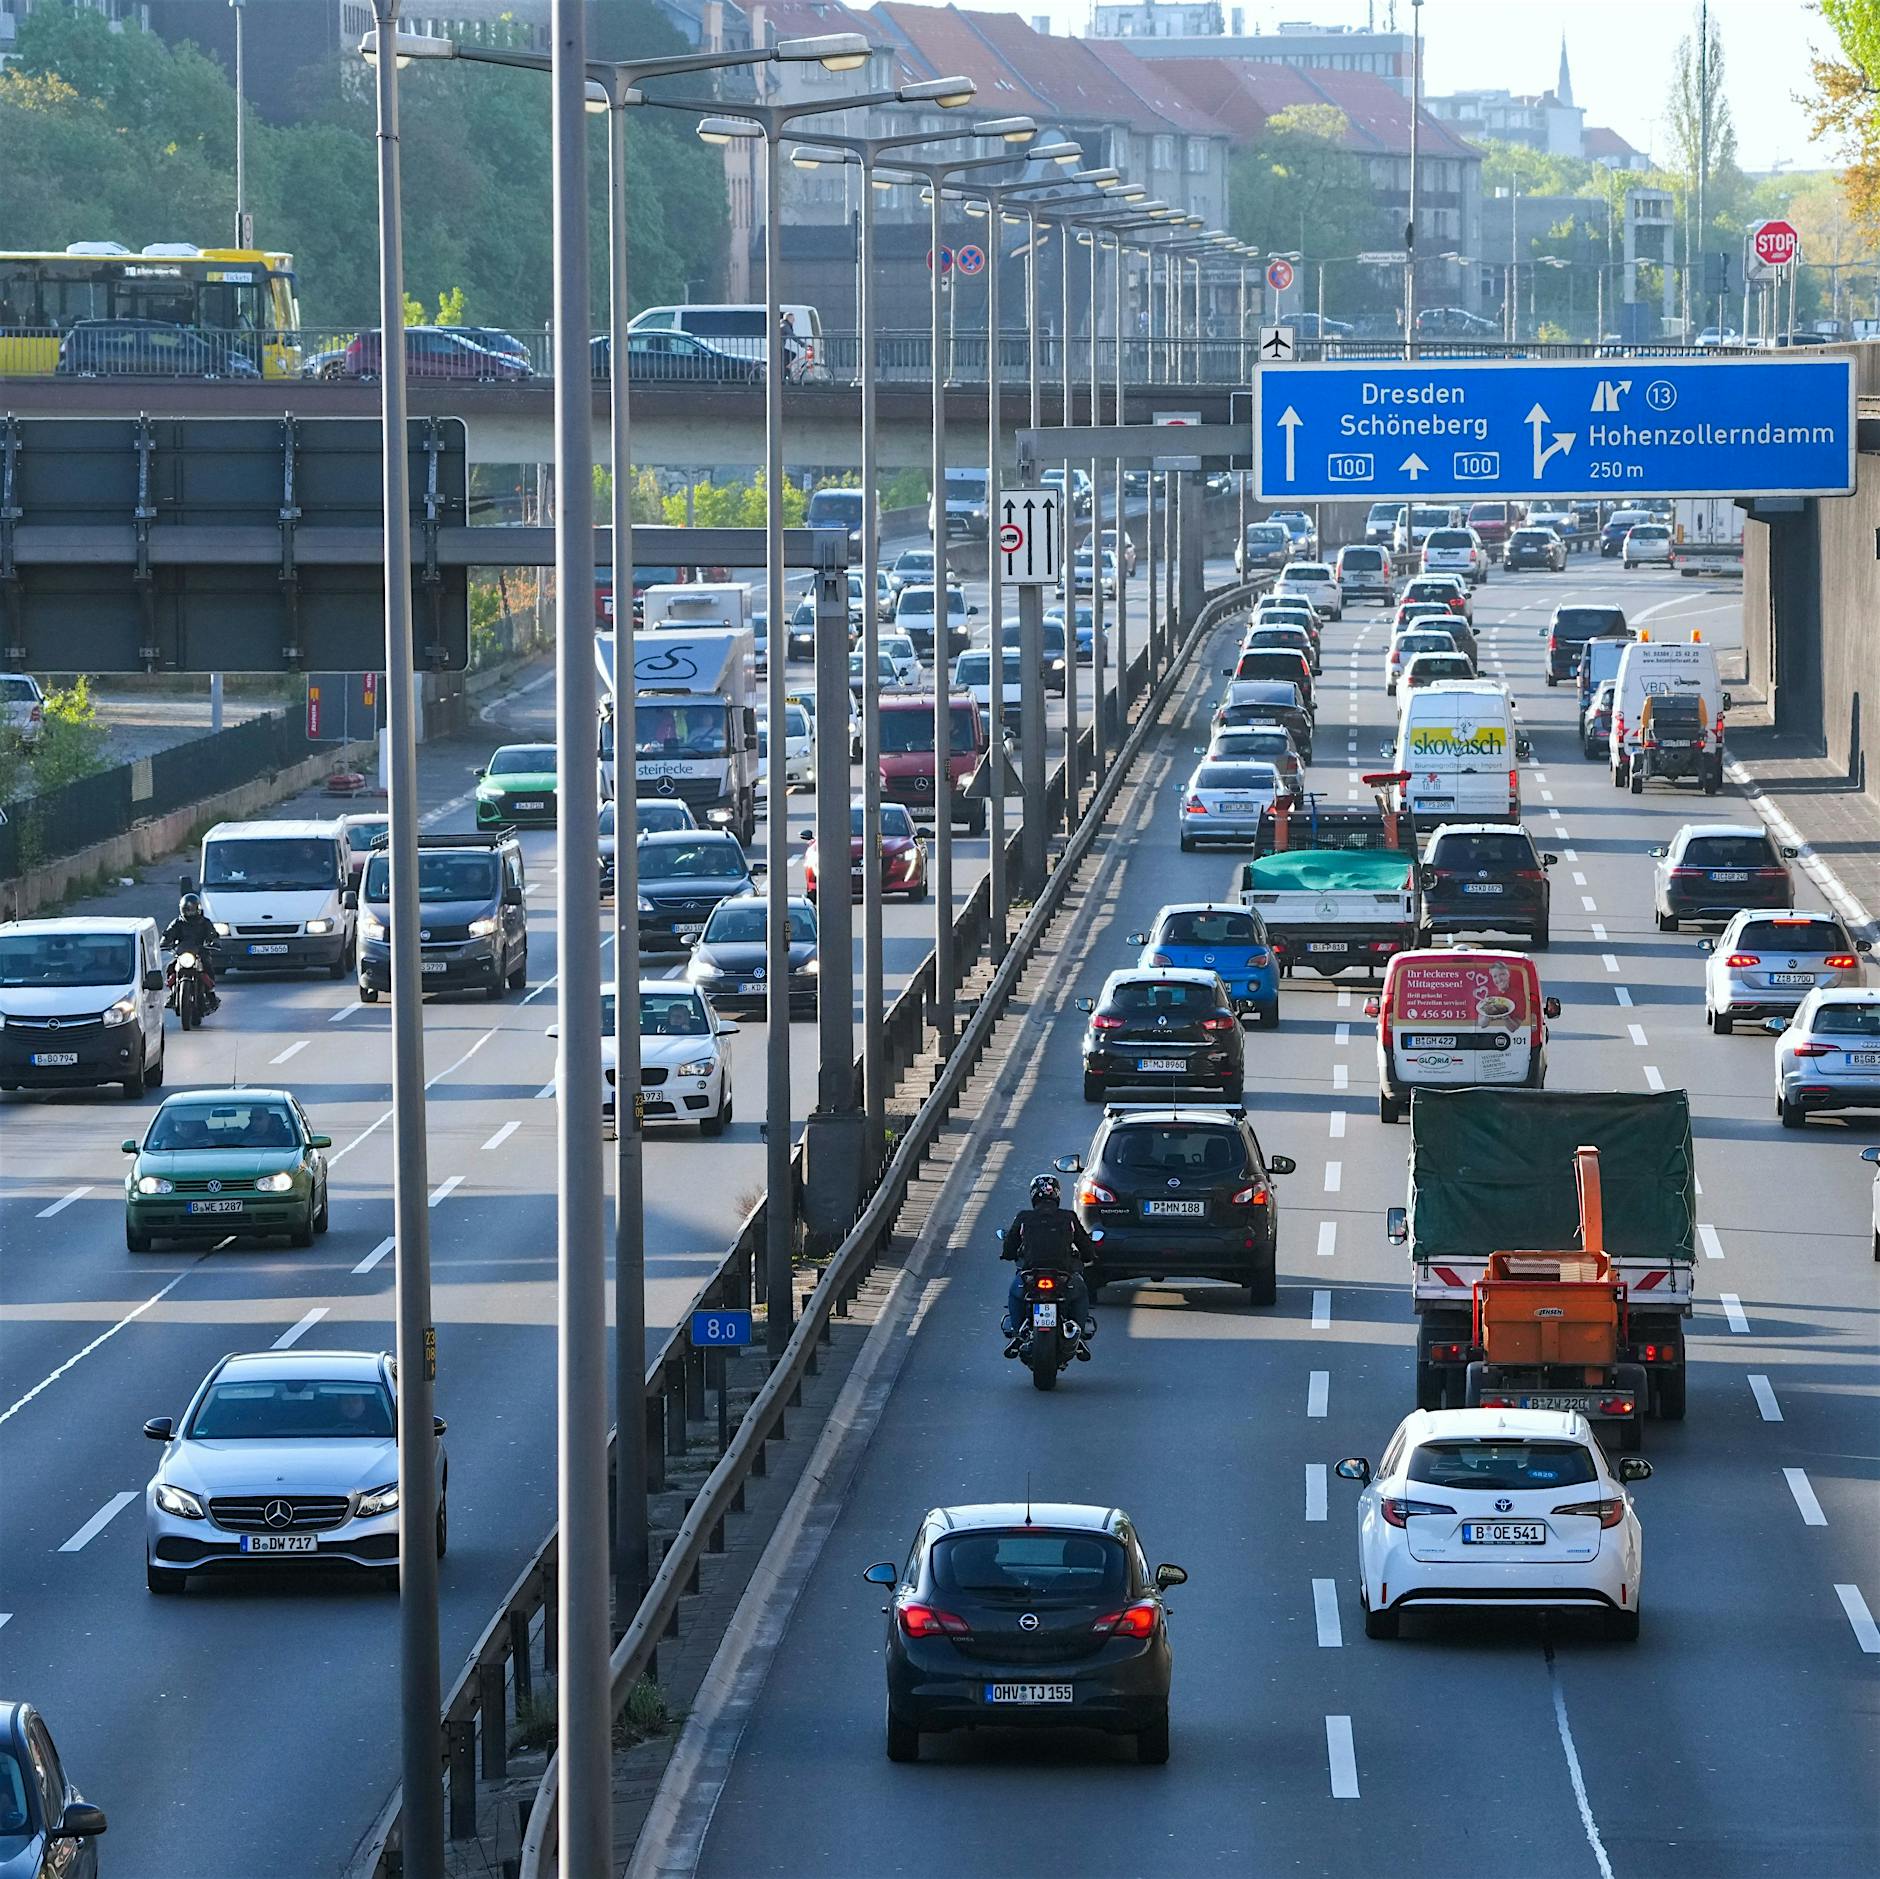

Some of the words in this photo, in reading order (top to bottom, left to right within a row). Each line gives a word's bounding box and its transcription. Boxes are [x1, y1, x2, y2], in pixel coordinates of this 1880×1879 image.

[1758, 233, 1796, 253] STOP
[1362, 383, 1465, 405] Dresden
[1652, 387, 1671, 404] 13
[1340, 414, 1488, 440] Schöneberg
[1588, 423, 1835, 447] Hohenzollerndamm
[1336, 459, 1366, 476] 100
[1461, 457, 1491, 474] 100
[1589, 461, 1622, 479] 250
[1627, 464, 1644, 478] m
[1413, 731, 1503, 757] skowasch
[1407, 969, 1421, 978] Ihr
[1423, 969, 1459, 978] leckeres
[1407, 980, 1463, 989] Mittagessen!
[1421, 1009, 1439, 1019] 456
[1441, 1009, 1453, 1019] 50
[1456, 1009, 1467, 1019] 15
[1512, 1037, 1526, 1045] 101
[1419, 1056, 1450, 1065] GLORIA
[1865, 1055, 1876, 1064] GB
[204, 1202, 217, 1212] WE
[219, 1201, 242, 1211] 1287
[1166, 1203, 1179, 1212] MN
[1181, 1203, 1200, 1213] 188
[425, 1331, 435, 1346] 23
[426, 1347, 436, 1361] 08
[1476, 1526, 1484, 1539] B
[1493, 1526, 1511, 1540] OE
[1513, 1526, 1538, 1540] 541
[252, 1537, 260, 1550] B
[269, 1537, 285, 1550] DW
[288, 1537, 312, 1550] 717
[994, 1686, 1019, 1700] OHV
[1029, 1686, 1045, 1700] TJ
[1049, 1686, 1072, 1700] 155
